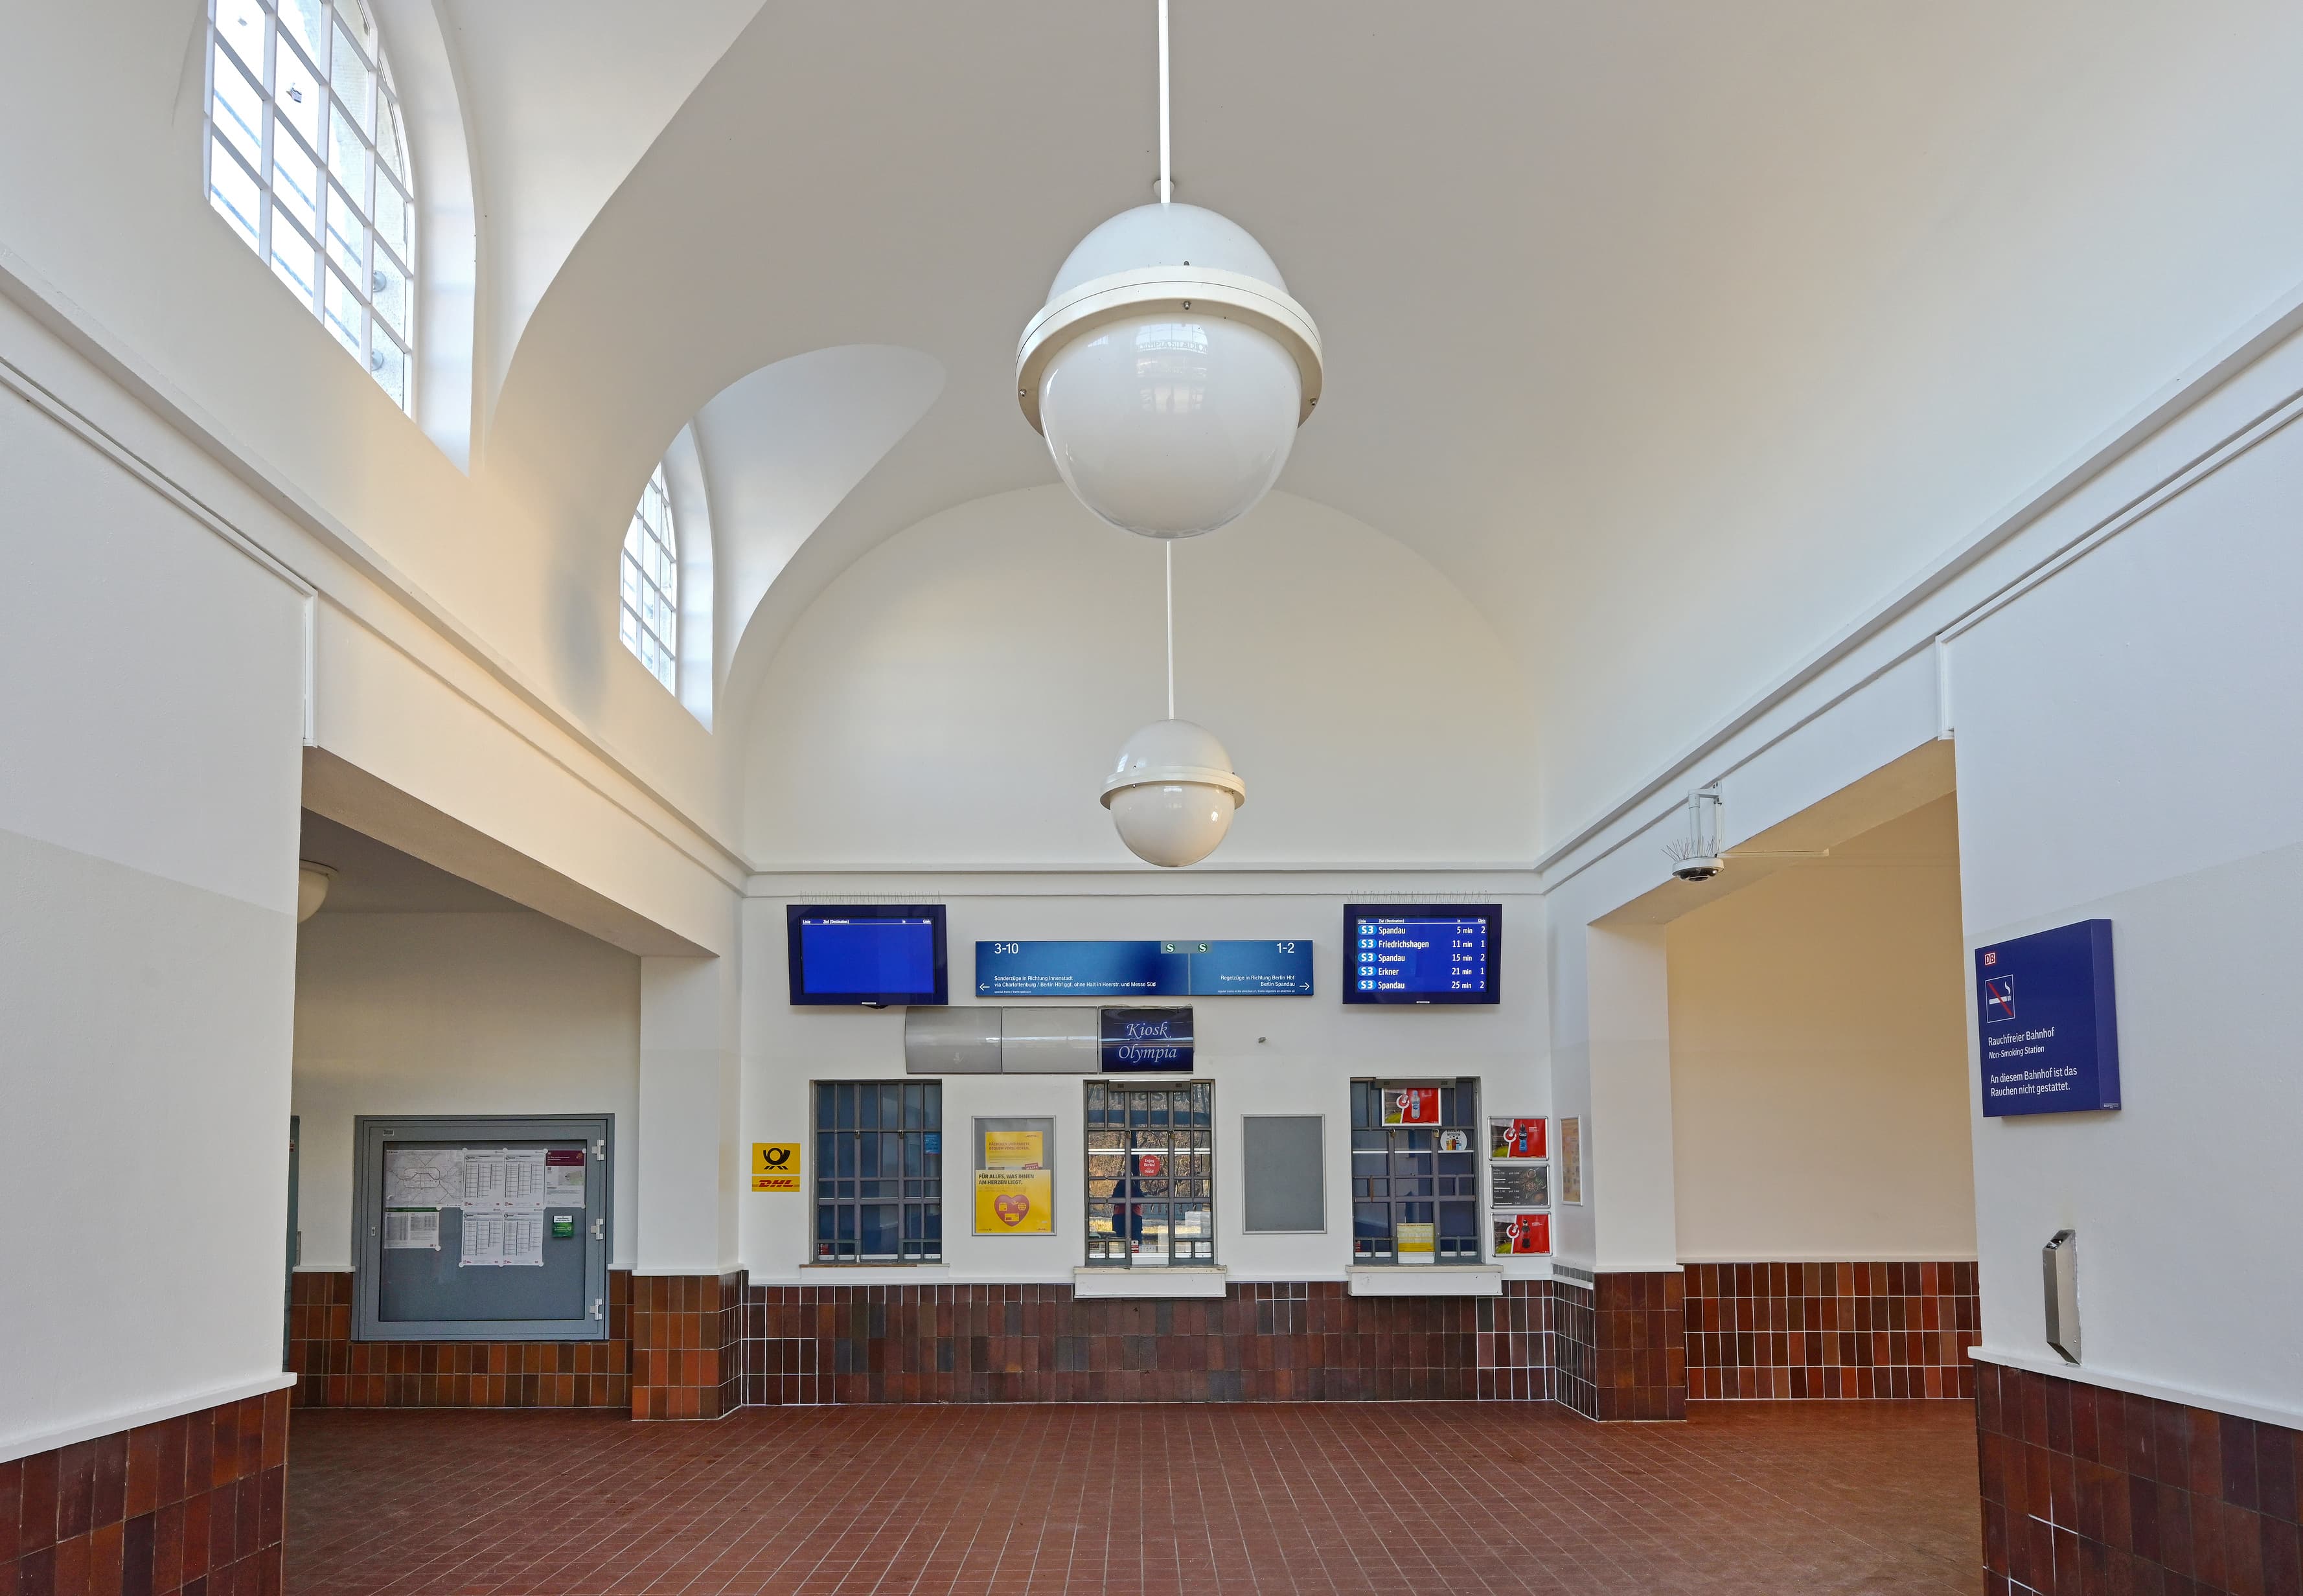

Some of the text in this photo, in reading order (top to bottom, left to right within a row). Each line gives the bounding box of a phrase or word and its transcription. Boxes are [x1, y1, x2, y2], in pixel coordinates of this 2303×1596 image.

[994, 942, 1019, 954] 3-10
[1166, 944, 1174, 952] S
[1198, 944, 1207, 952] S
[1277, 942, 1294, 953] 1-2
[1379, 940, 1429, 949] Friedrichshagen
[1378, 954, 1405, 963] Spandau
[1985, 953, 1995, 964] DB
[1127, 1021, 1171, 1038] Kiosk
[1988, 1027, 2055, 1046] Rauchfreier Bahnhof
[1119, 1043, 1178, 1062] Olympia
[1989, 1045, 2045, 1059] Non-Smoking Station
[1990, 1066, 2077, 1084] An diesem Bahnhof ist das
[1991, 1082, 2070, 1097] Rauchen nicht gestattet.
